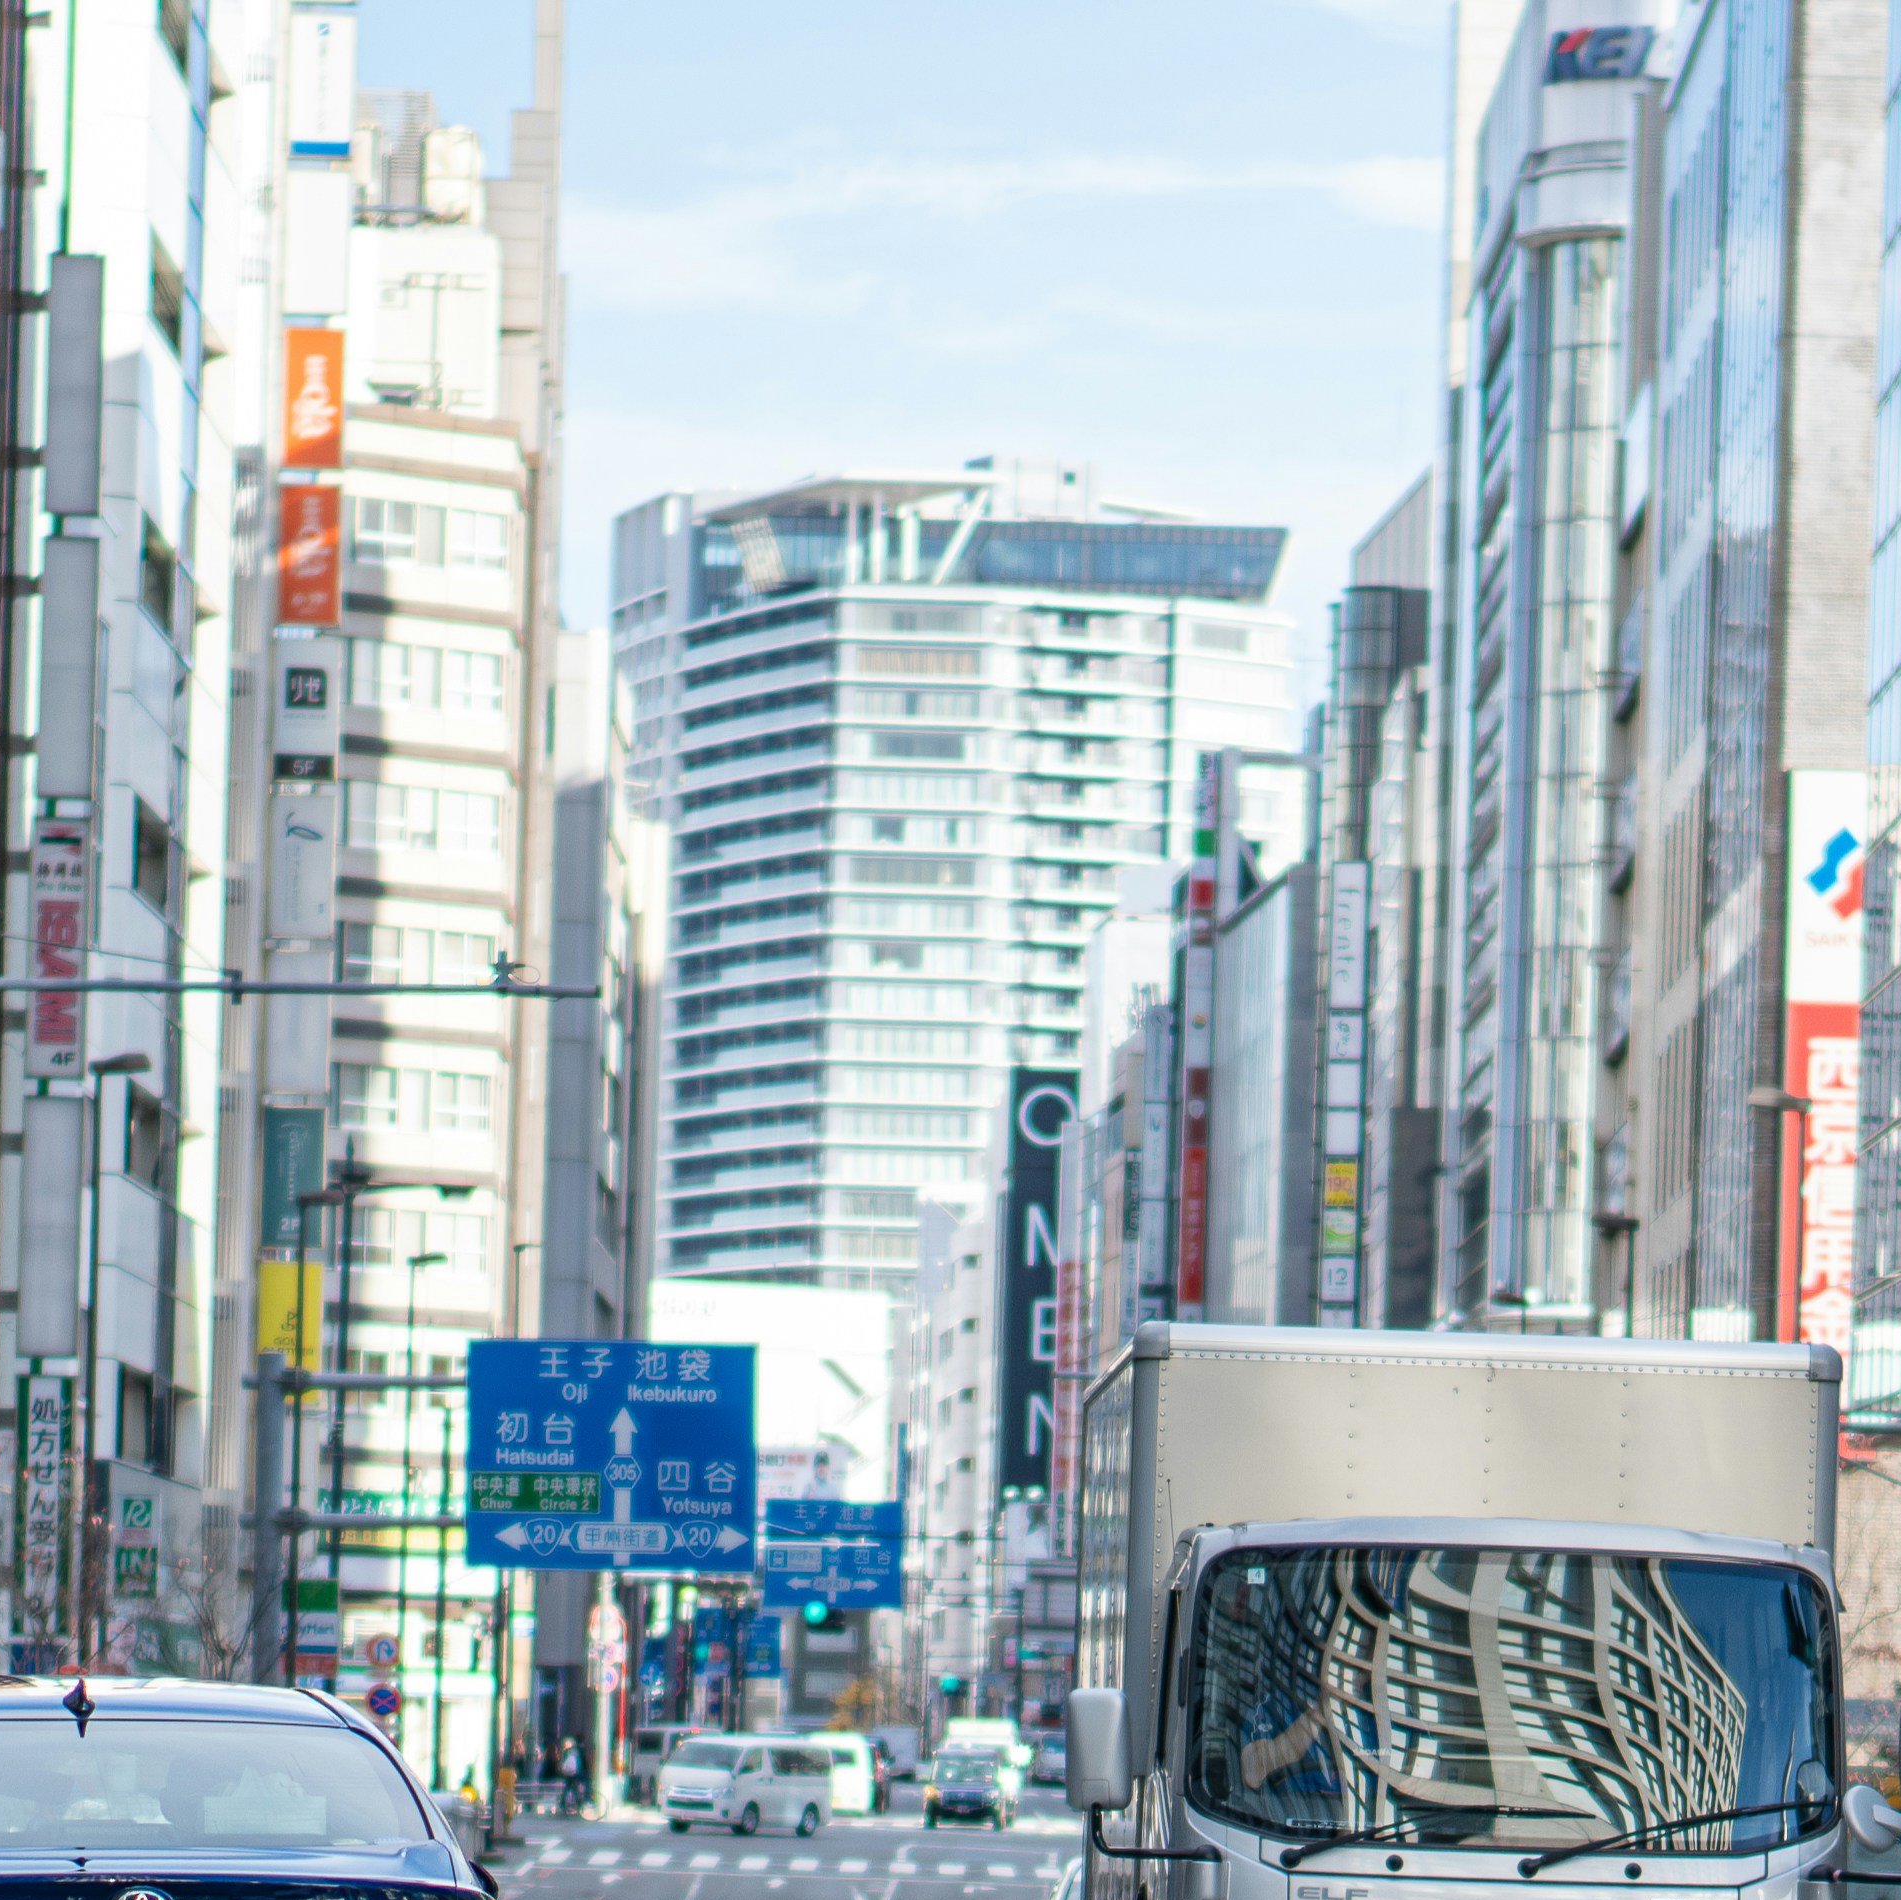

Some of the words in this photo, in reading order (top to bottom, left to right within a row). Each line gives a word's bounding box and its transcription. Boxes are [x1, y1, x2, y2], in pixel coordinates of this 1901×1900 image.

[52, 1052, 76, 1066] 4F
[1802, 1037, 1860, 1350] 西京信用金
[539, 1347, 613, 1378] 王子
[636, 1350, 711, 1381] 池袋
[562, 1383, 588, 1403] Oji
[627, 1384, 717, 1403] Ikebukuro
[496, 1411, 575, 1444] 初台
[496, 1448, 574, 1465] Hatsudai
[609, 1464, 637, 1481] 305
[658, 1461, 736, 1493] 四谷
[473, 1476, 520, 1497] 中央道
[533, 1476, 597, 1497] 中央環状
[479, 1498, 512, 1509] Chuo
[540, 1498, 578, 1511] Circle
[662, 1497, 732, 1518] Yotsuya
[533, 1525, 556, 1544] 20
[585, 1529, 660, 1549] 甲州街道
[688, 1527, 711, 1546] 20
